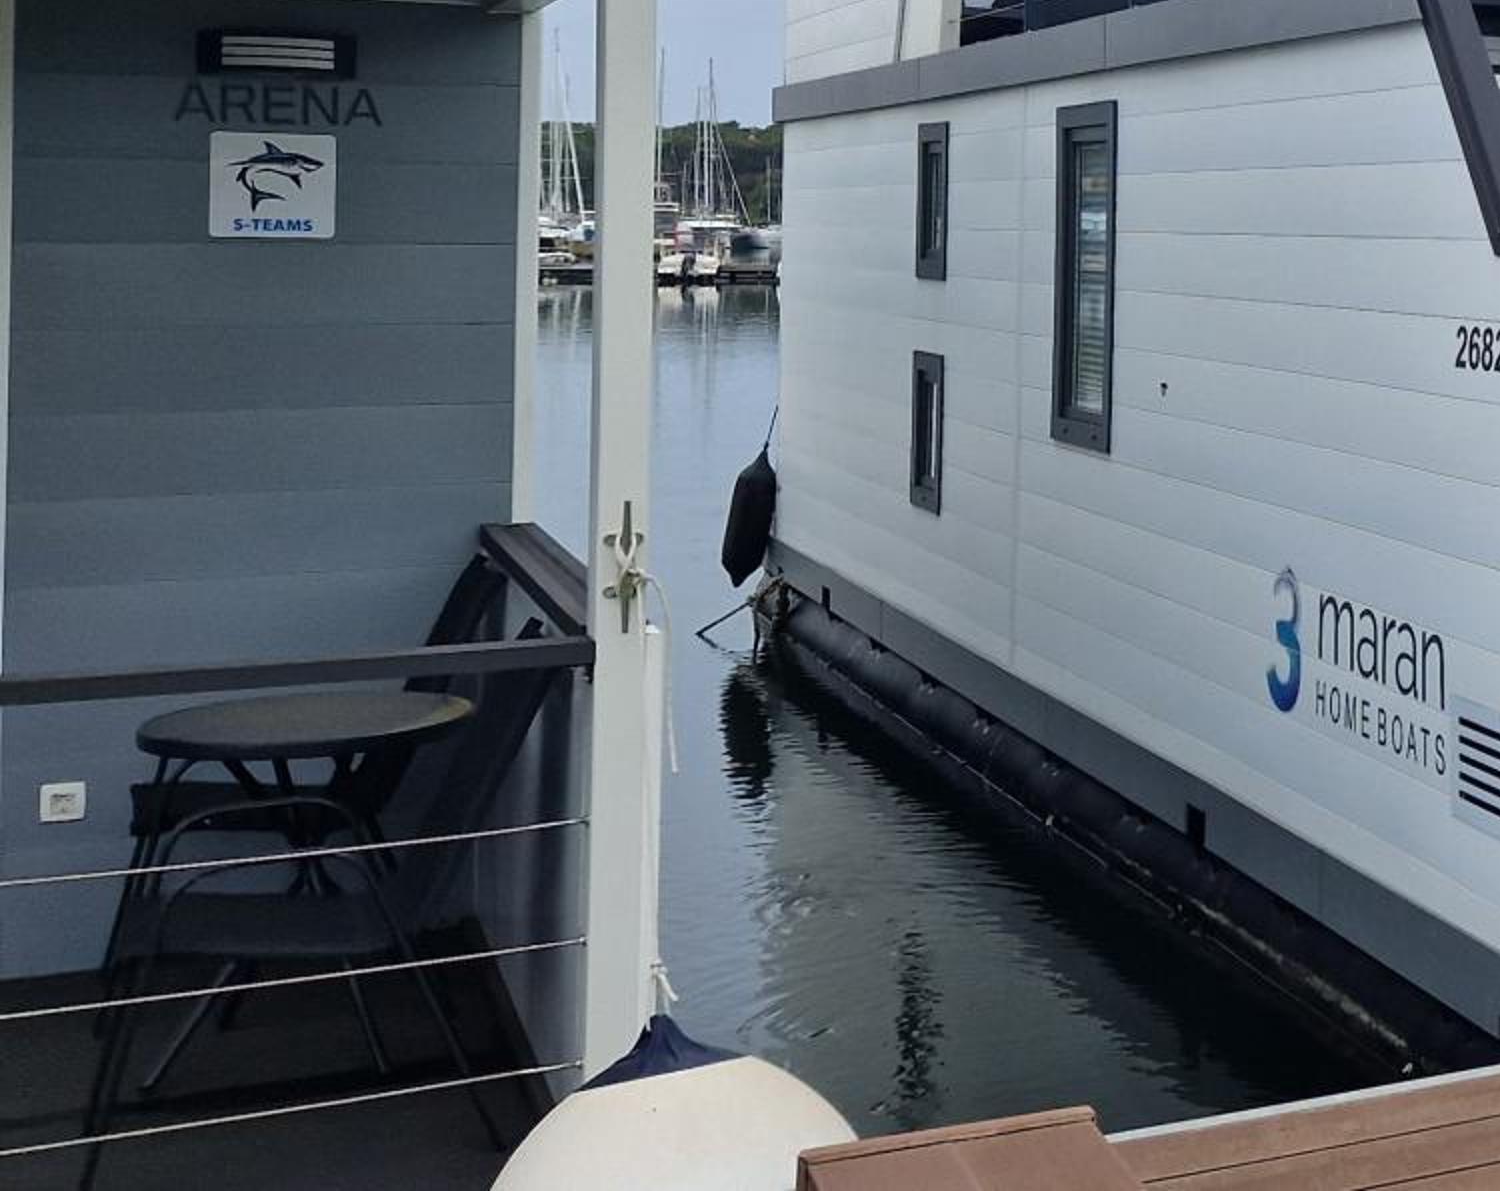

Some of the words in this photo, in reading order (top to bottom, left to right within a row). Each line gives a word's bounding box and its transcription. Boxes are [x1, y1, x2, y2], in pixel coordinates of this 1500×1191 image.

[174, 82, 382, 127] ARENA
[233, 218, 313, 232] S-TEAMS
[1317, 593, 1446, 711] maran
[1315, 680, 1446, 776] HOMEBOATS
